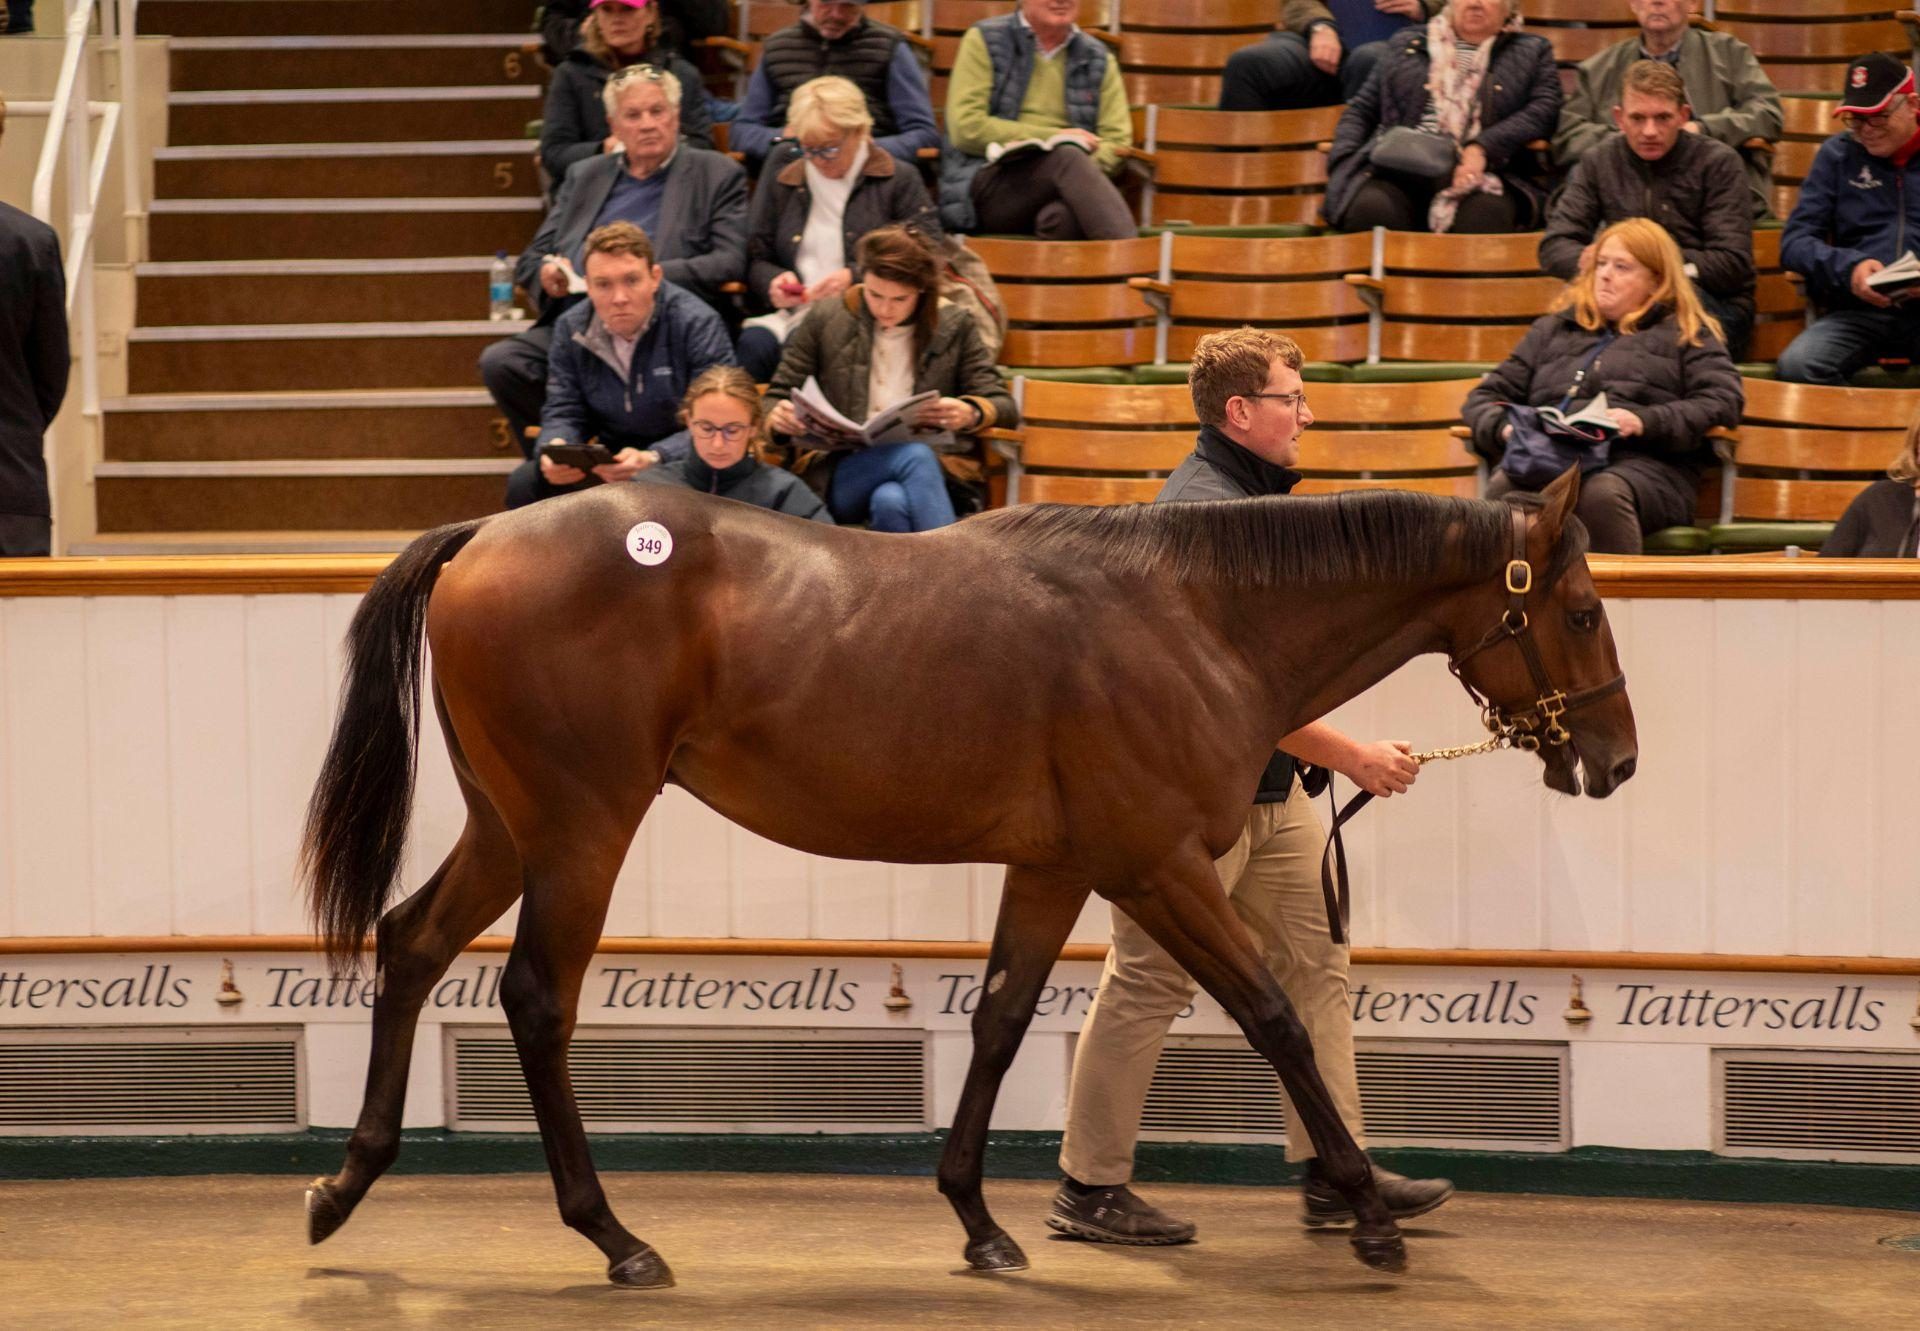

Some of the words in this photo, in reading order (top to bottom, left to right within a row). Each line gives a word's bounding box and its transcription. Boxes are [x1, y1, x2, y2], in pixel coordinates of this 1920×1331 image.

[503, 51, 523, 79] 6
[493, 161, 513, 190] 5
[489, 416, 512, 449] 3
[636, 536, 662, 555] 349
[0, 964, 192, 1009] ttersalls
[600, 967, 859, 1012] Tattersalls
[1349, 980, 1539, 1025] tersalls
[1615, 984, 1886, 1032] Tattersalls
